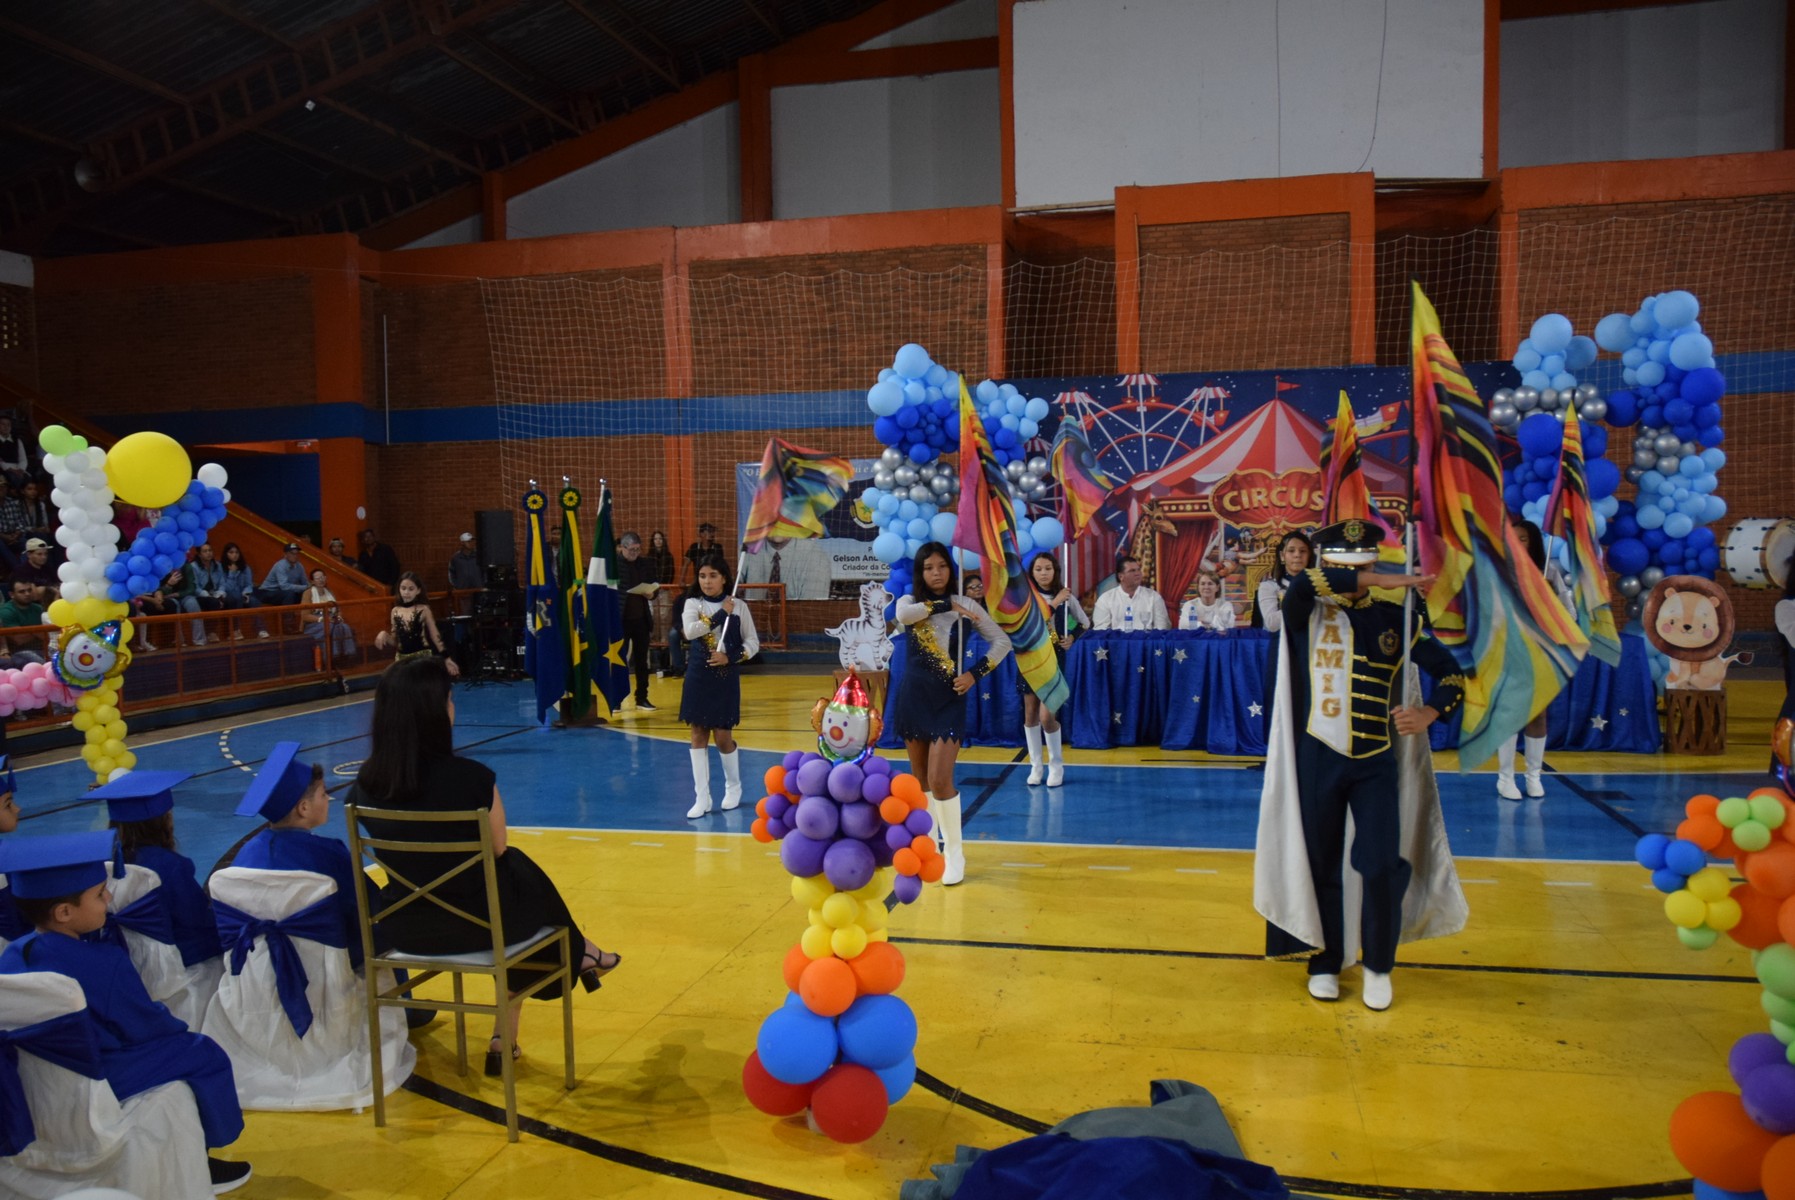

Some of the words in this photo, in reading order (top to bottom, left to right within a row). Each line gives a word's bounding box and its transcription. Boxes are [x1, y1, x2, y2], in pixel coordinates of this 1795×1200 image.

[1223, 486, 1325, 512] CIRCUS
[833, 554, 860, 562] Gelson
[842, 563, 868, 571] Criador
[870, 563, 879, 571] da
[1315, 603, 1345, 718] FAMIG
